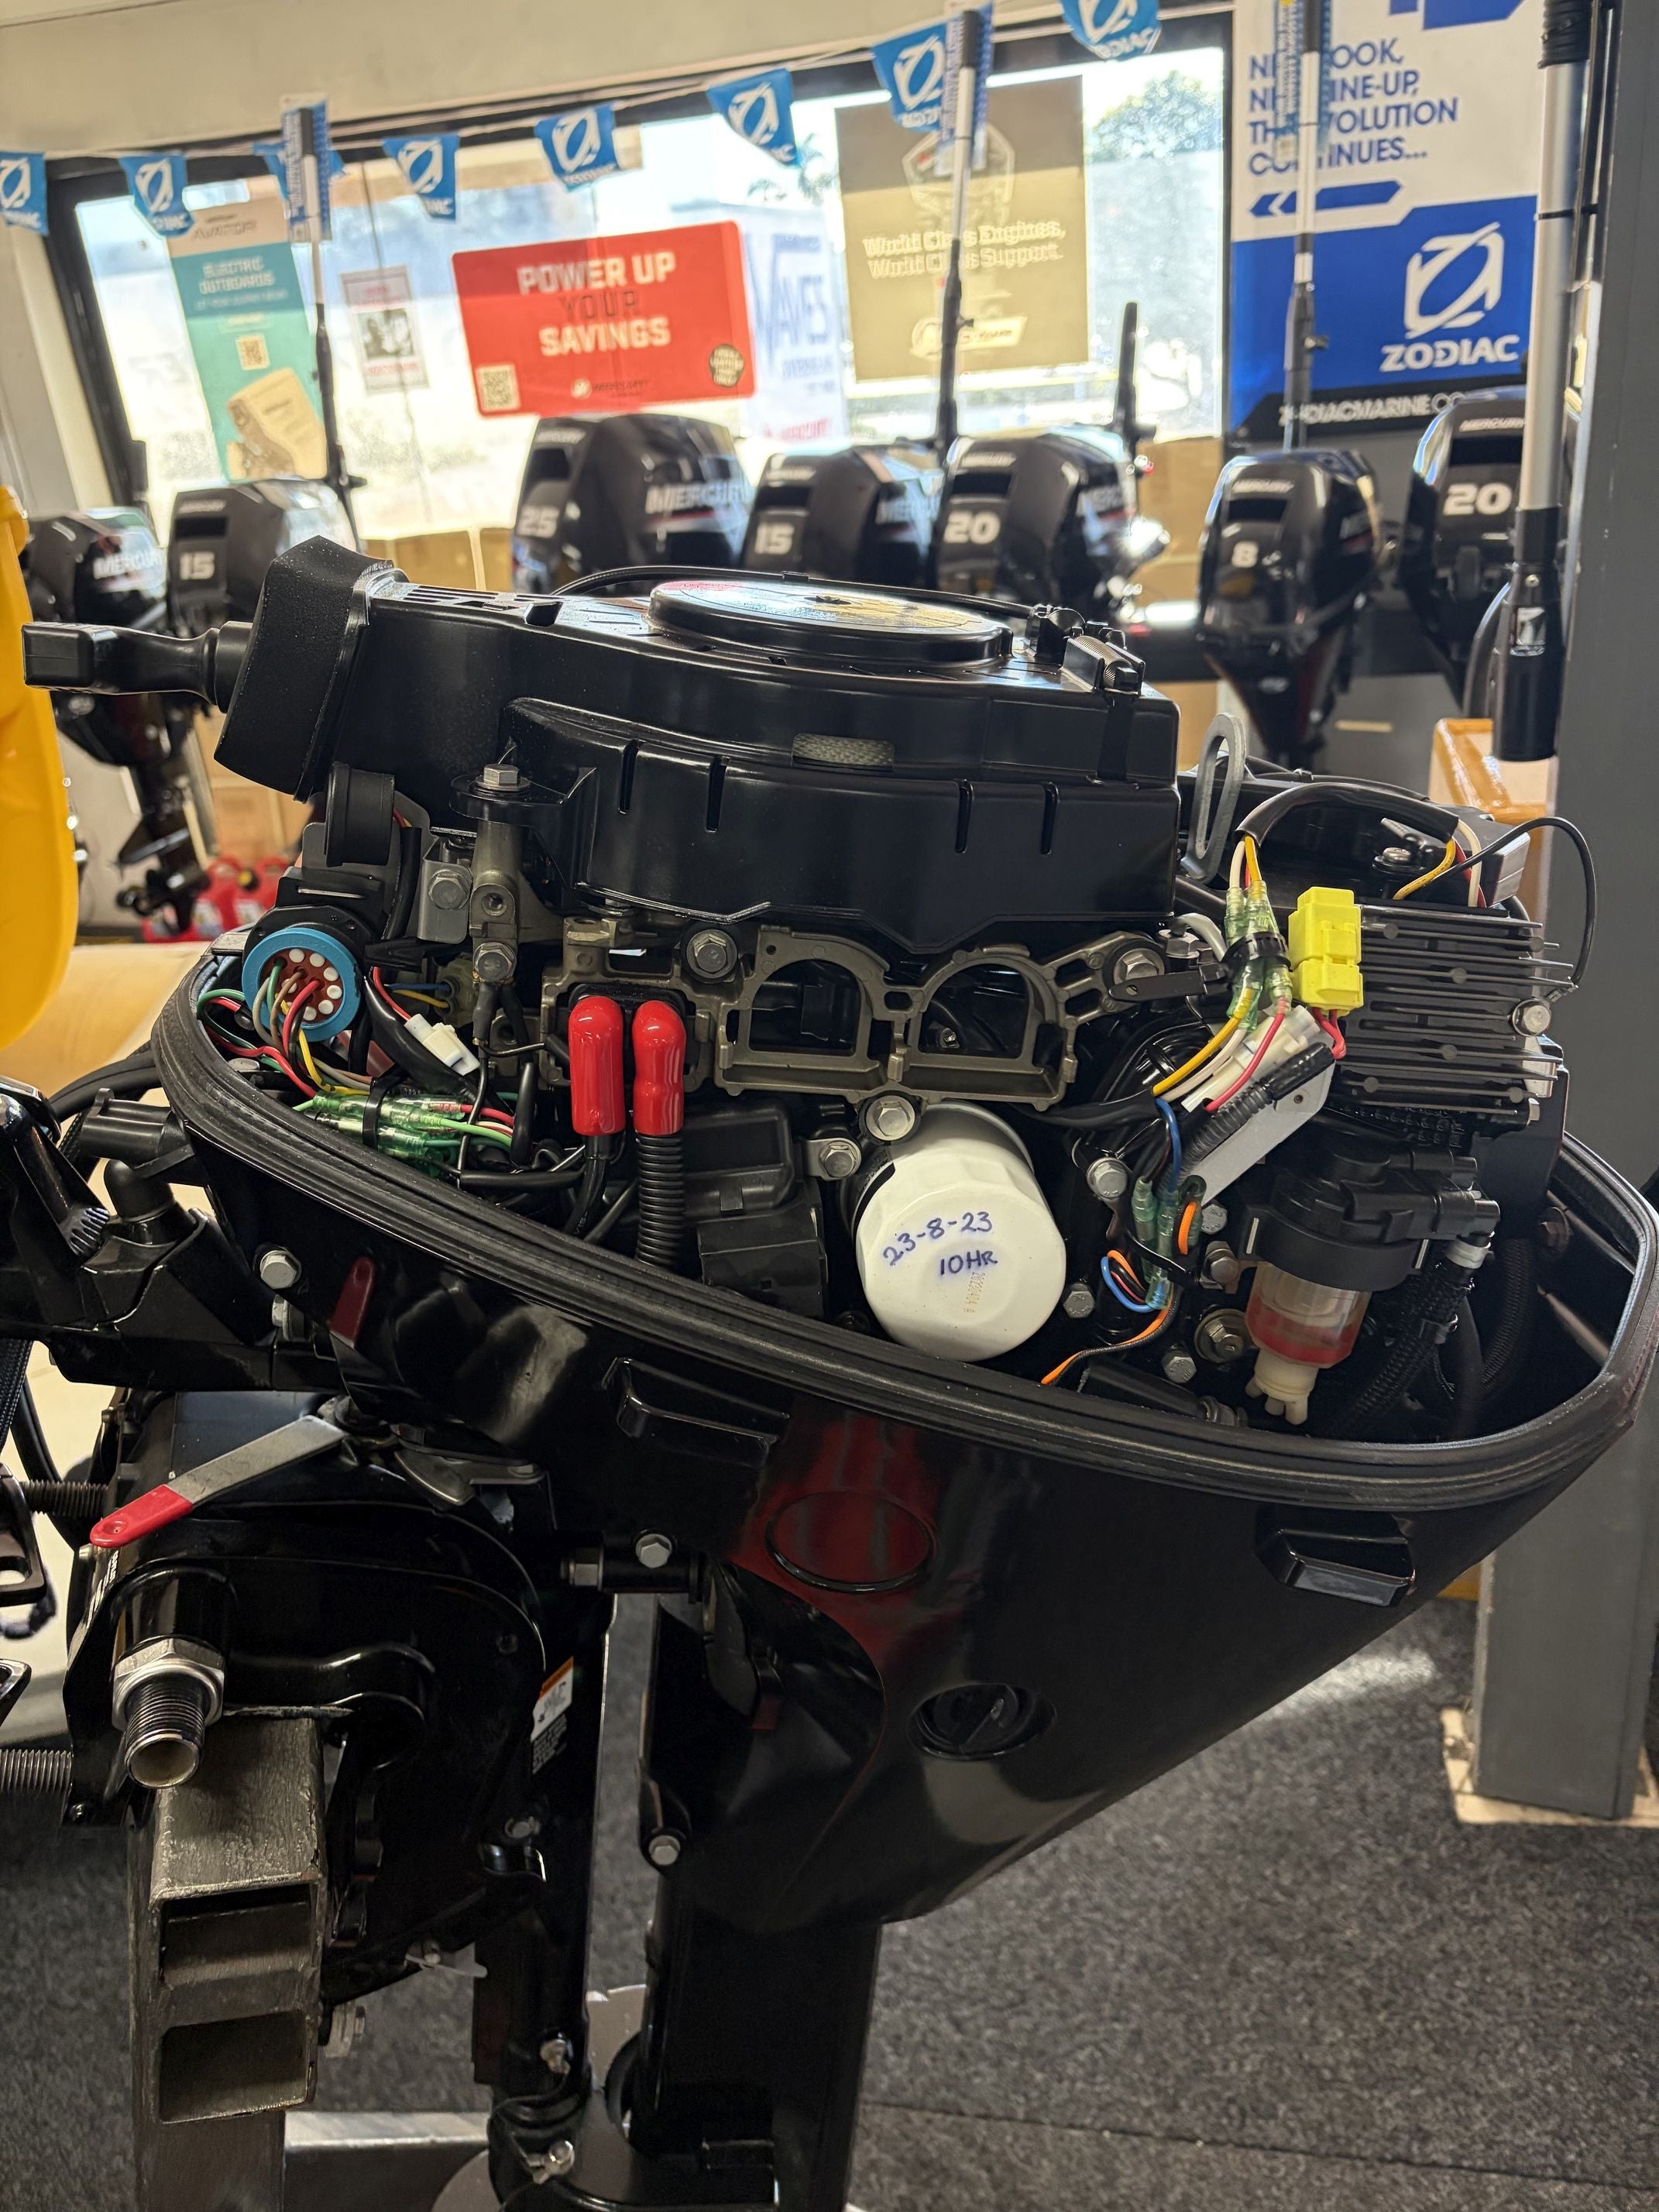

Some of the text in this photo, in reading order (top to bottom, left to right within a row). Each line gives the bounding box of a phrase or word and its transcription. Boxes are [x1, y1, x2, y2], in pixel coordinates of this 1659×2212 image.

[1331, 37, 1403, 70] OOK,
[1329, 69, 1420, 104] INE-UP,
[517, 251, 676, 294] POWER UP
[558, 290, 641, 320] YOUR
[538, 316, 672, 356] SAVINGS
[1379, 335, 1520, 373] ZODIAC
[1442, 482, 1513, 516] 20
[517, 506, 559, 538] 25
[754, 520, 795, 555] 15
[943, 510, 1001, 545] 20
[179, 551, 216, 580] 15
[1231, 541, 1259, 568] 8
[883, 1211, 993, 1266] 23-8-23
[939, 1249, 998, 1276] 10HR
